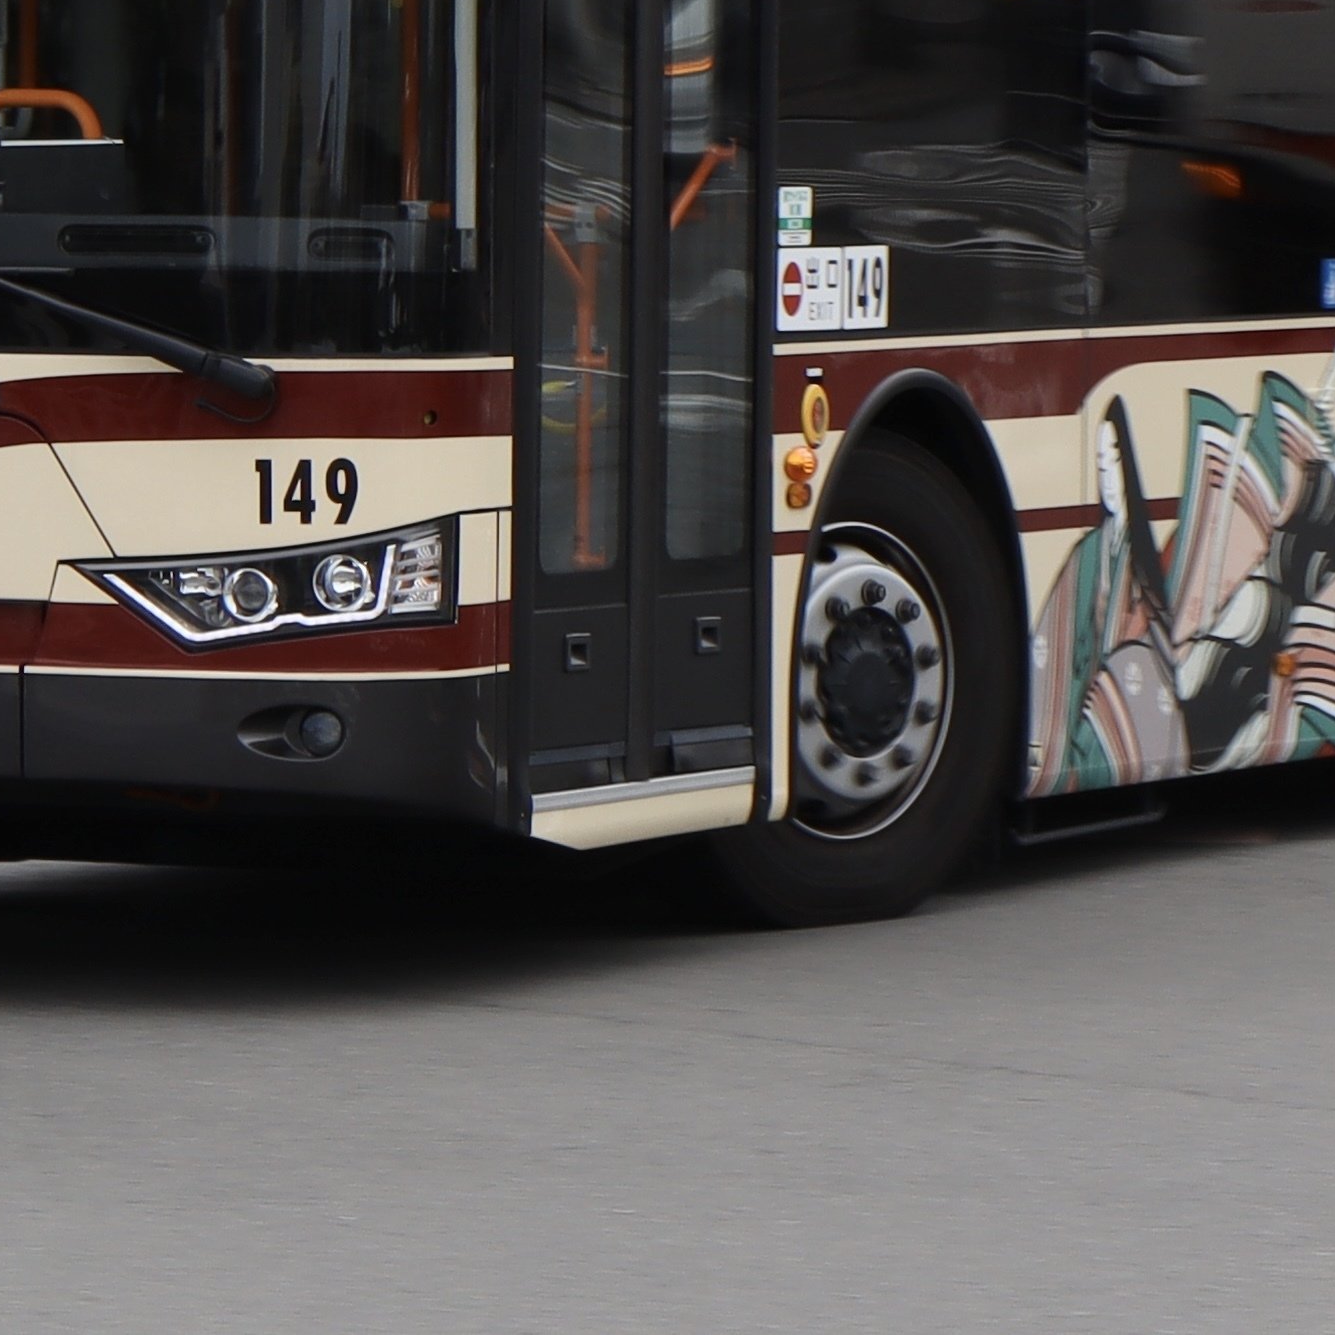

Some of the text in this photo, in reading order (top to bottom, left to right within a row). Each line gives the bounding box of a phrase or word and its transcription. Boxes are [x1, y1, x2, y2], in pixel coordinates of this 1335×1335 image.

[808, 301, 835, 321] EXIT
[847, 256, 885, 319] 149
[255, 457, 359, 524] 149
